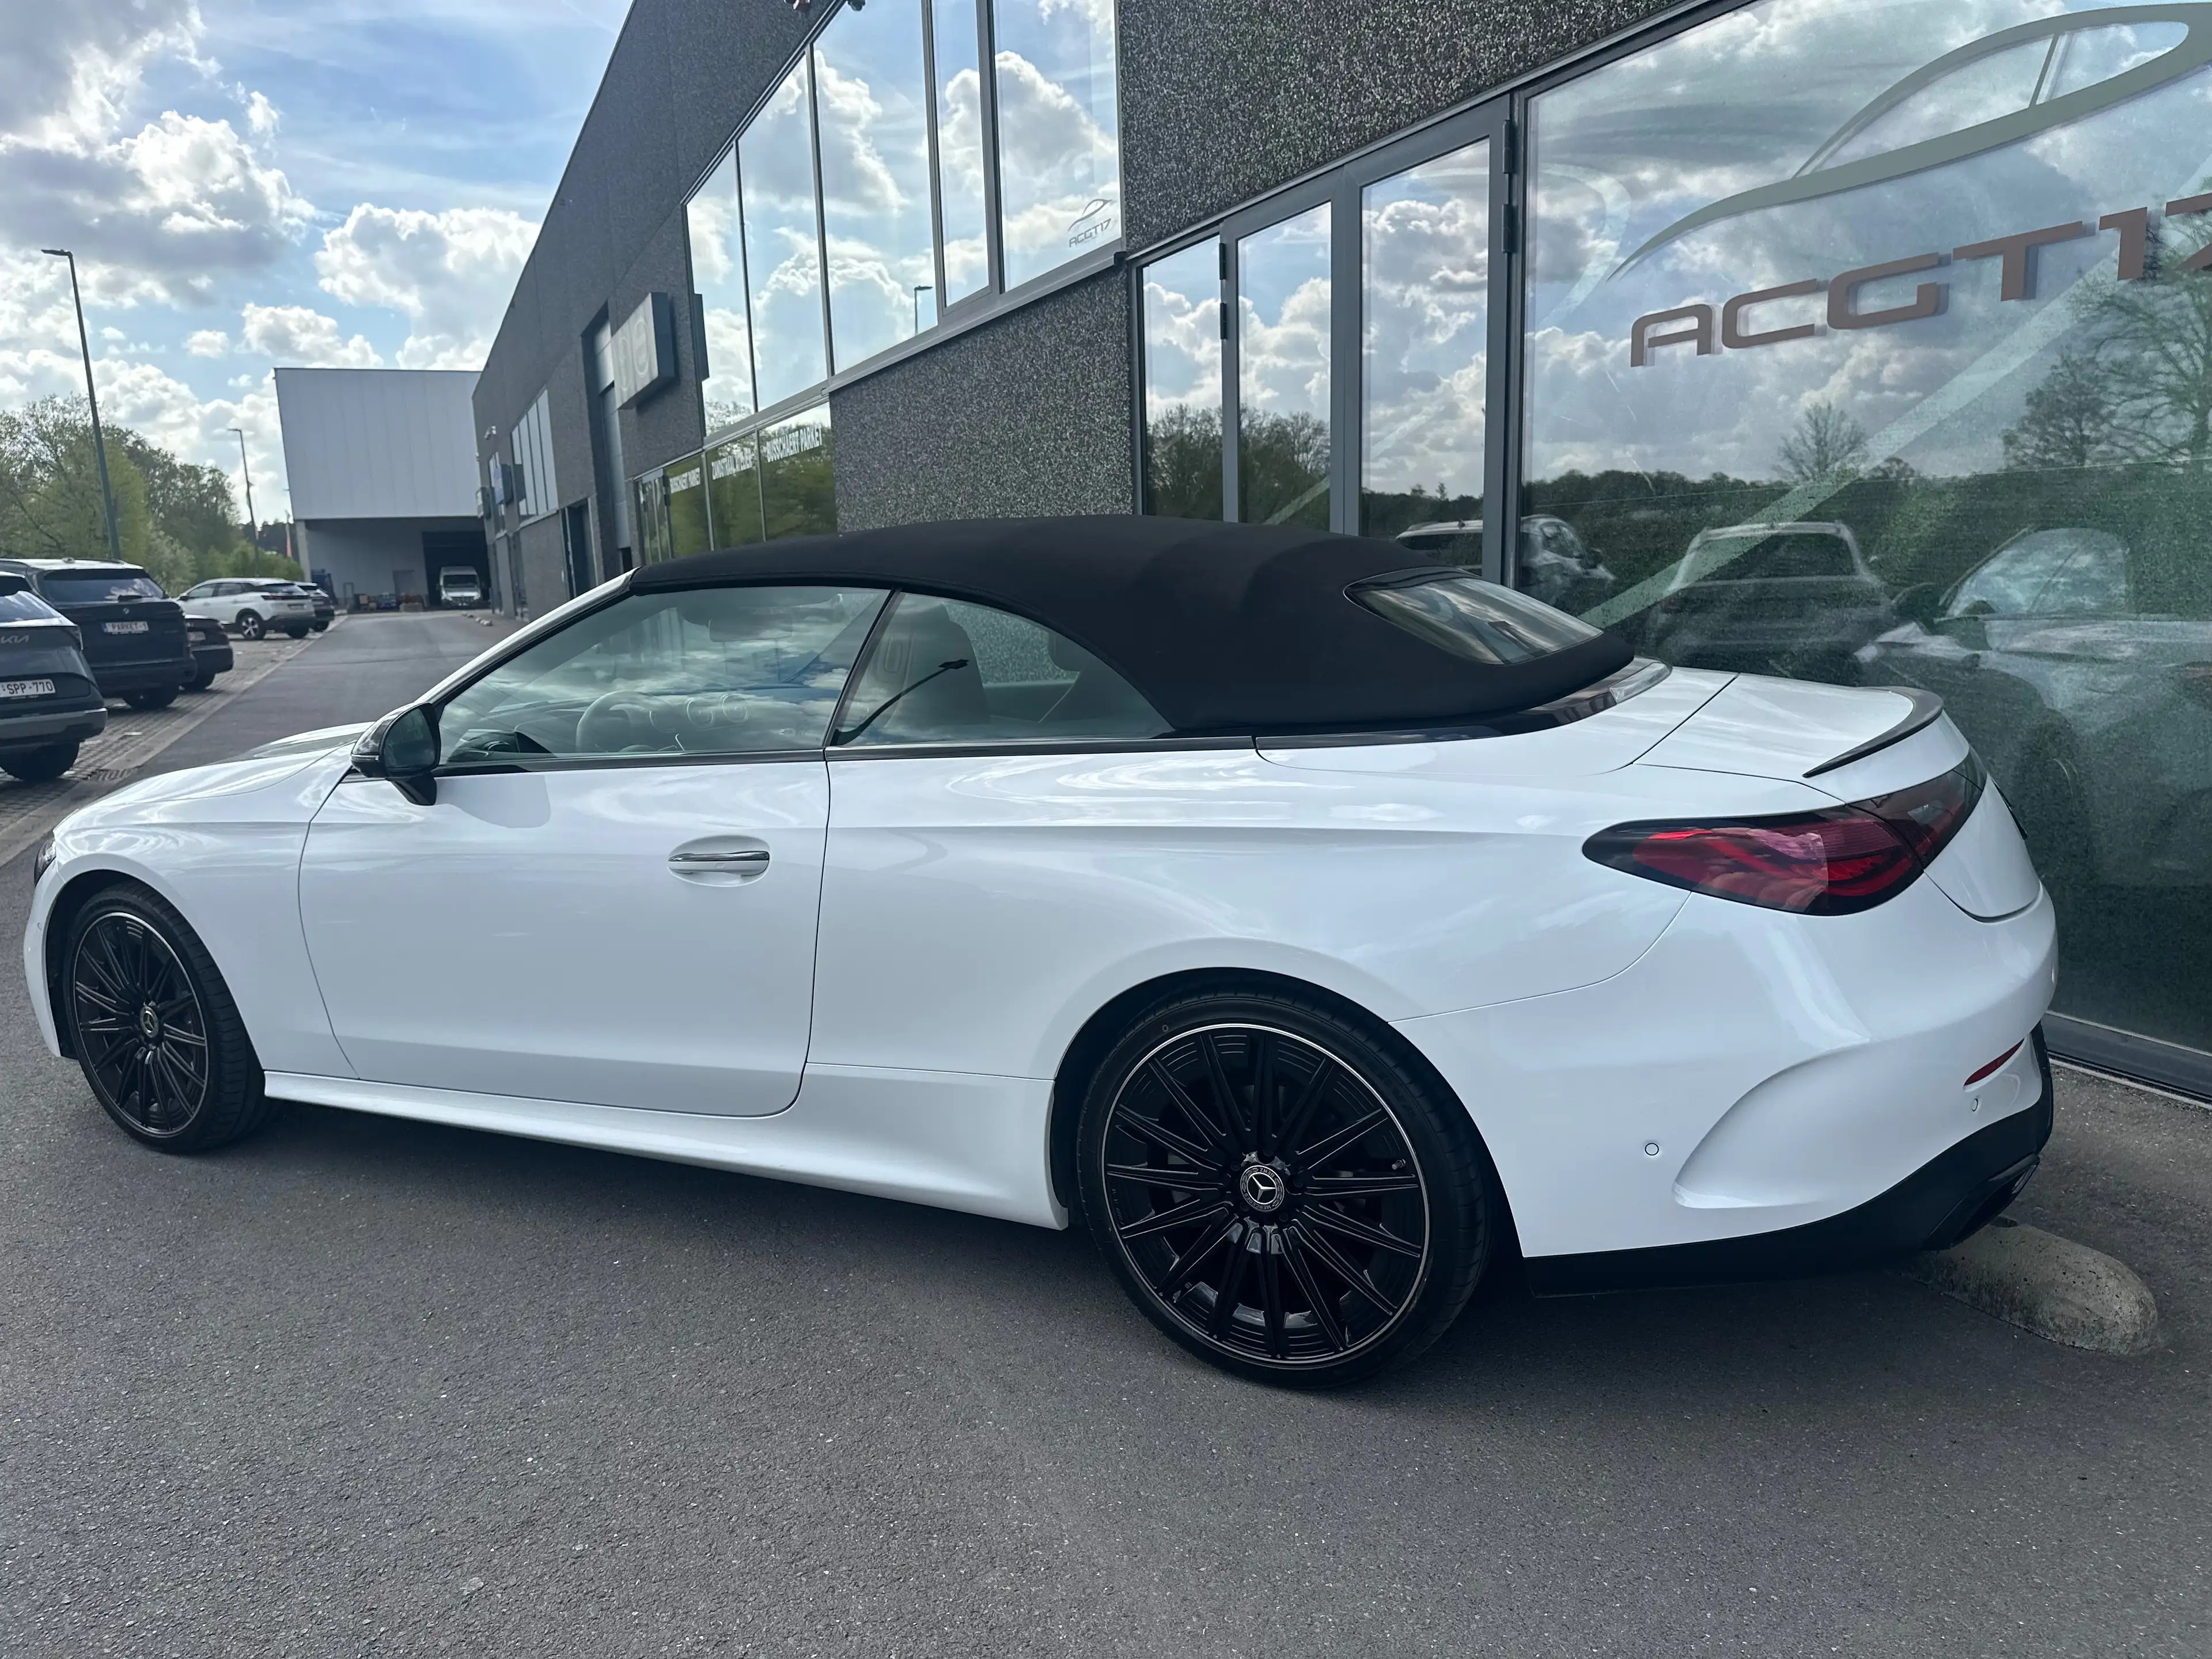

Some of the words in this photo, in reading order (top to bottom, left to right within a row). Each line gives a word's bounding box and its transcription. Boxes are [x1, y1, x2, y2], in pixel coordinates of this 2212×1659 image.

[1069, 218, 1111, 248] ACGT17
[800, 423, 823, 452] PARKET
[1260, 1167, 1275, 1178] BENZ
[1244, 1192, 1271, 1210] MERCEDES
